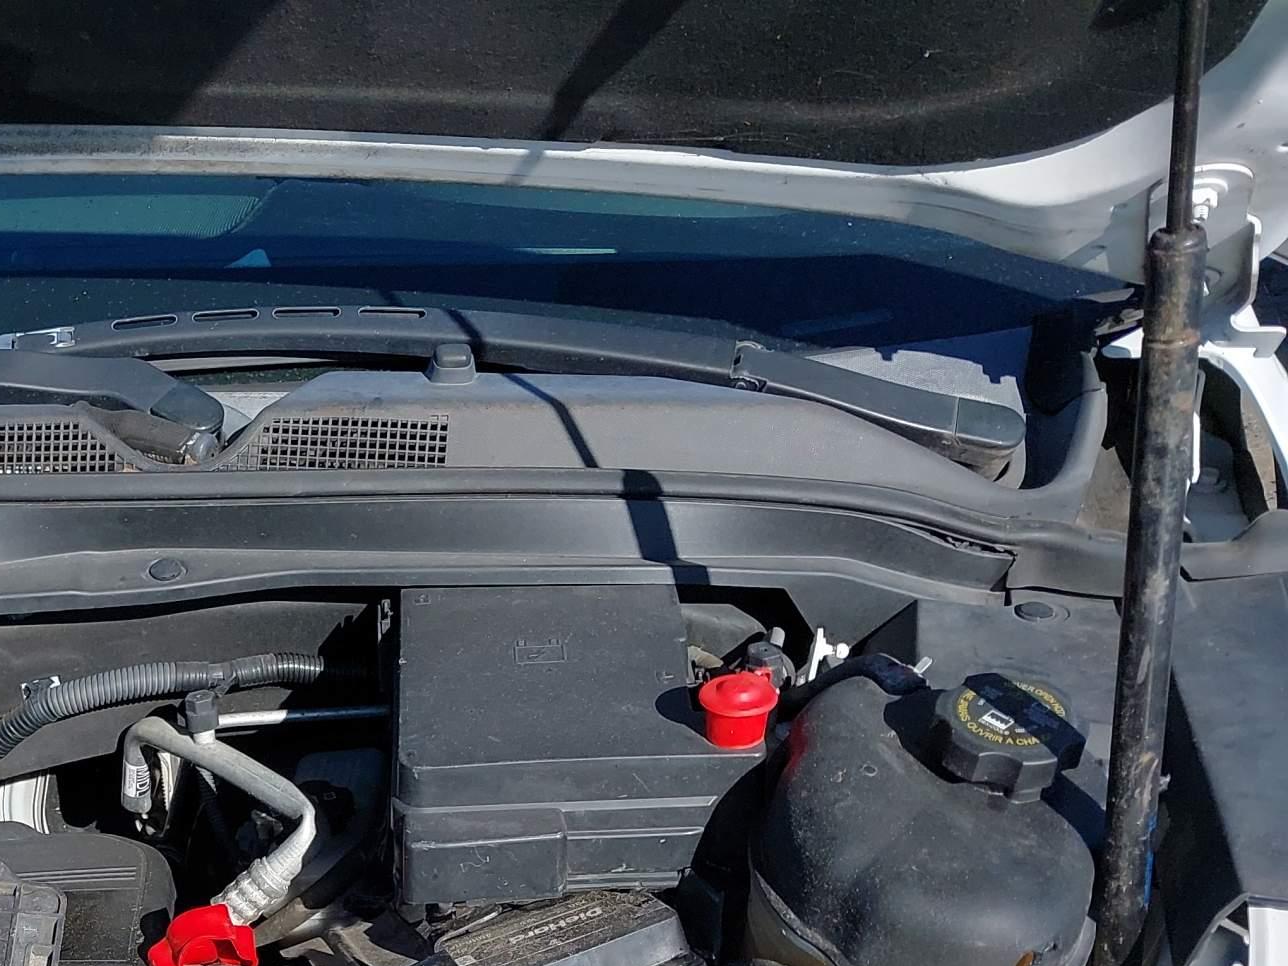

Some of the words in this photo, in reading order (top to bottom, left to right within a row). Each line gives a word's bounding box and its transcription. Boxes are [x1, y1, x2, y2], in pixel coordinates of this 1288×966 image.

[967, 722, 1003, 743] OUVRIR
[135, 767, 151, 798] MIDL
[509, 907, 603, 945] DieHard
